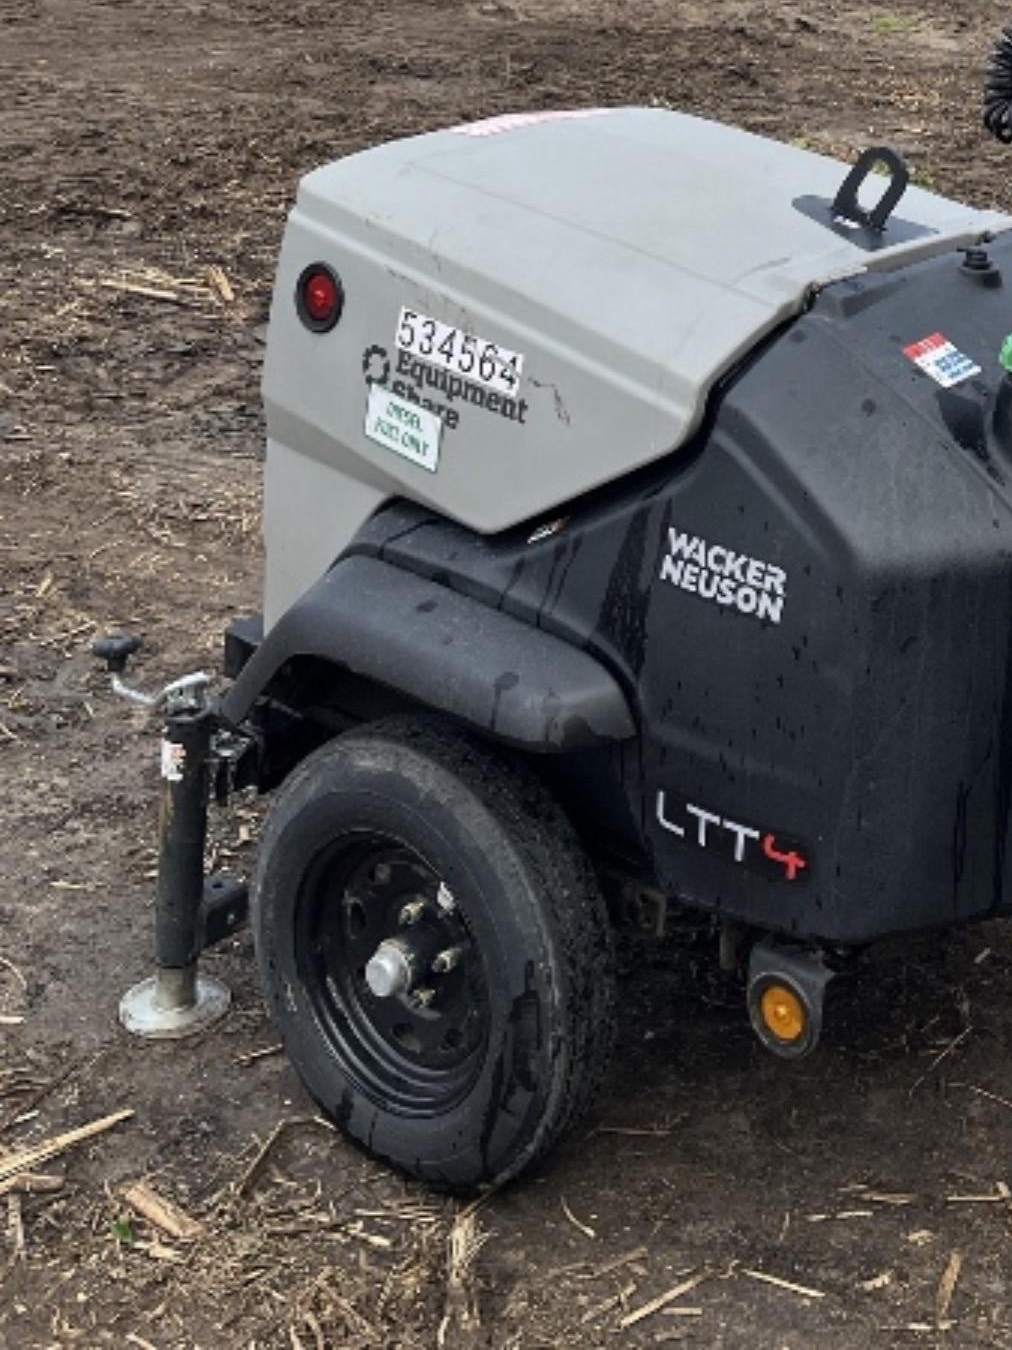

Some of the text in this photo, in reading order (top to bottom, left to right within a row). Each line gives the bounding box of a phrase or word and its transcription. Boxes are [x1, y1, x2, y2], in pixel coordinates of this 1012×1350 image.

[395, 348, 529, 424] Equipment
[398, 311, 520, 391] 534564
[658, 554, 785, 625] NEUSON
[668, 526, 788, 596] WACKER
[656, 790, 806, 880] LTT4
